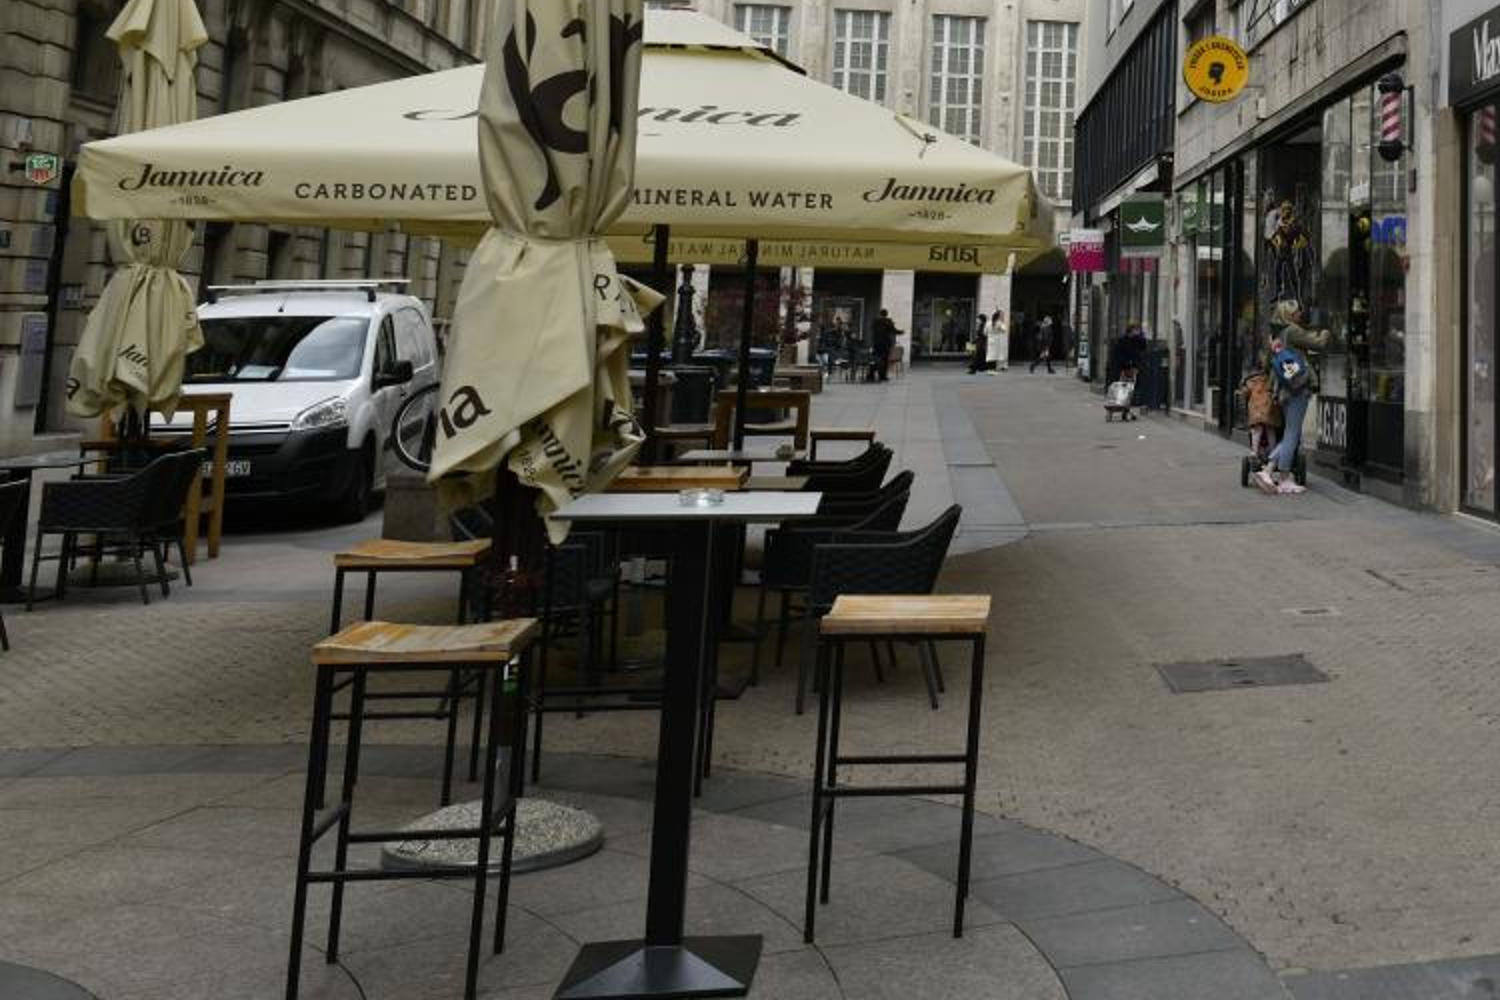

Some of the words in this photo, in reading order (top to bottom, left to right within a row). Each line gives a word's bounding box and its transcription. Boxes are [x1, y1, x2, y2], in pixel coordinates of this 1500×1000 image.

[118, 164, 264, 191] Jamnica
[863, 177, 996, 205] Jamnica
[294, 182, 477, 201] CARBONATED
[748, 190, 833, 209] WATER
